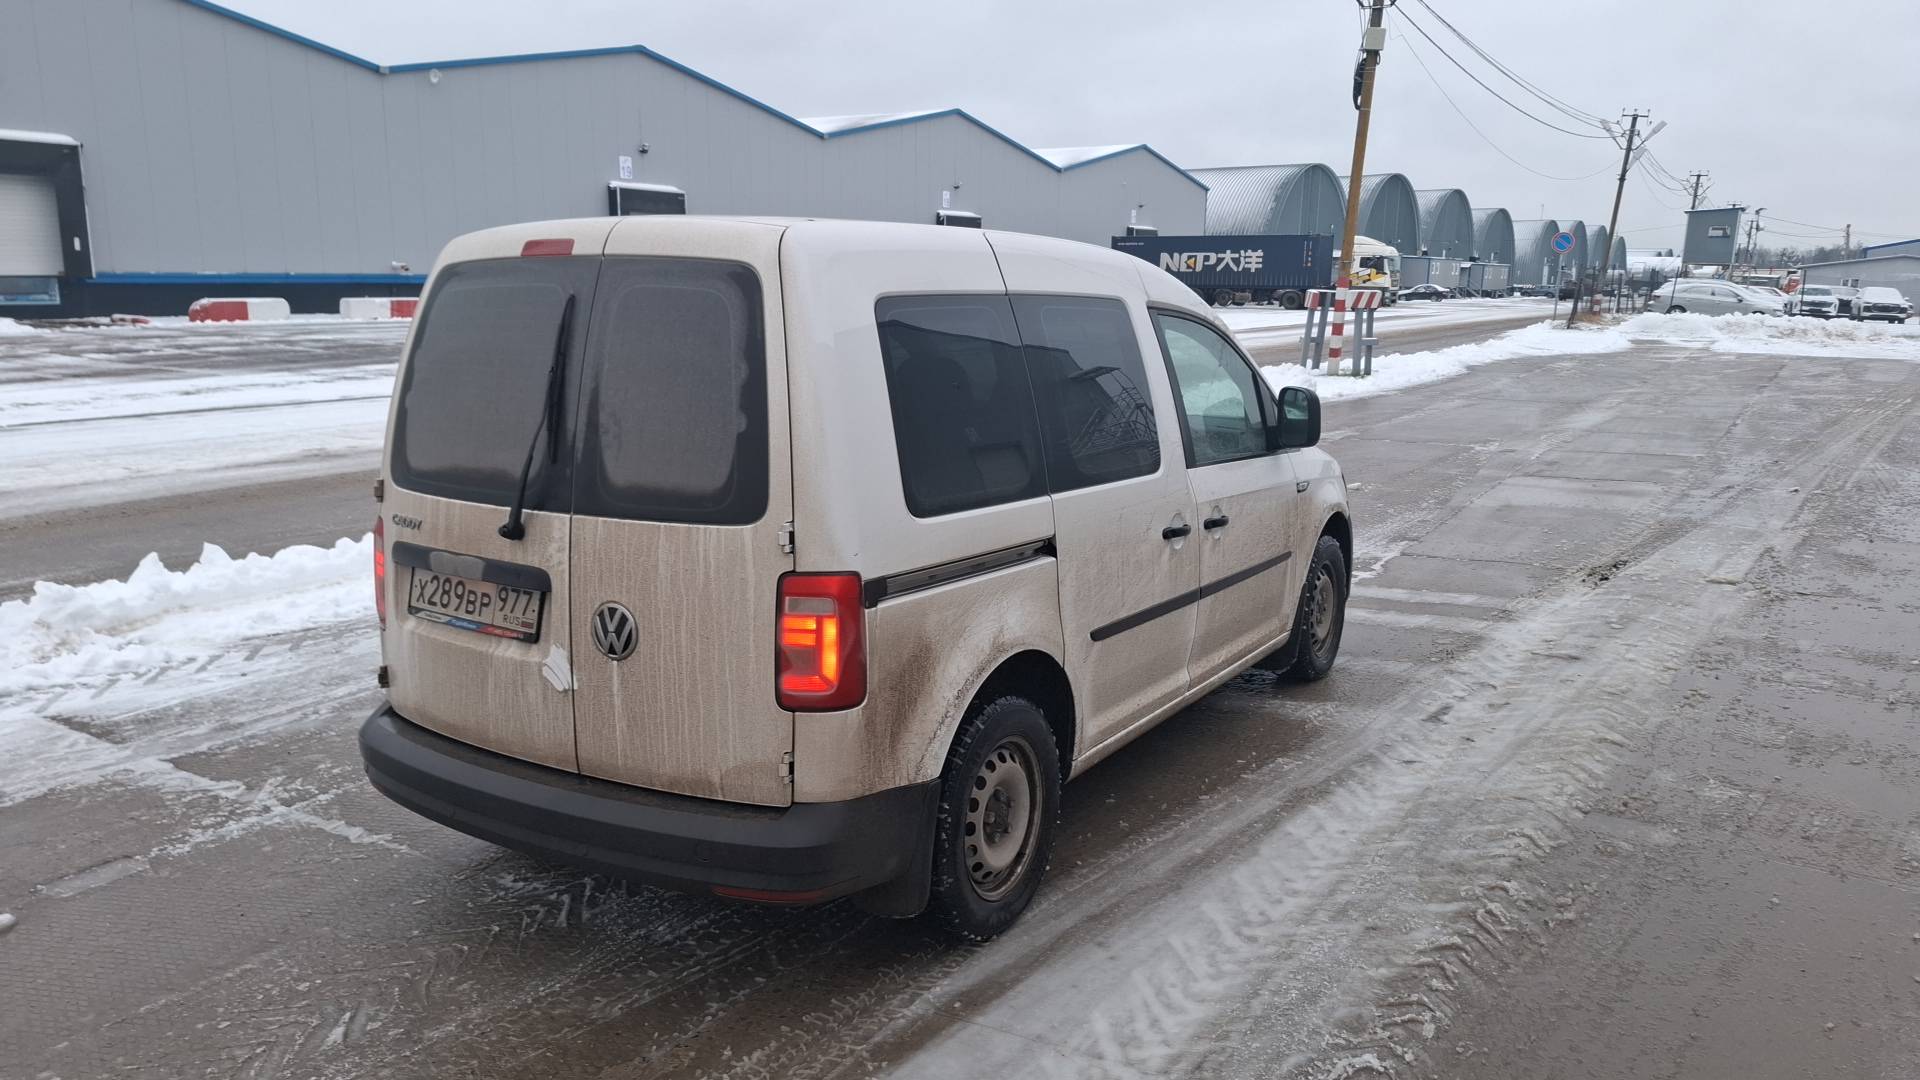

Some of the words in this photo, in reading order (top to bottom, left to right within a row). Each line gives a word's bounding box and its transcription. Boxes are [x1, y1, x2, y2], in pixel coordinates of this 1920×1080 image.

[1217, 249, 1264, 272] 大洋
[498, 586, 533, 616] 977
[503, 614, 521, 627] RUS
